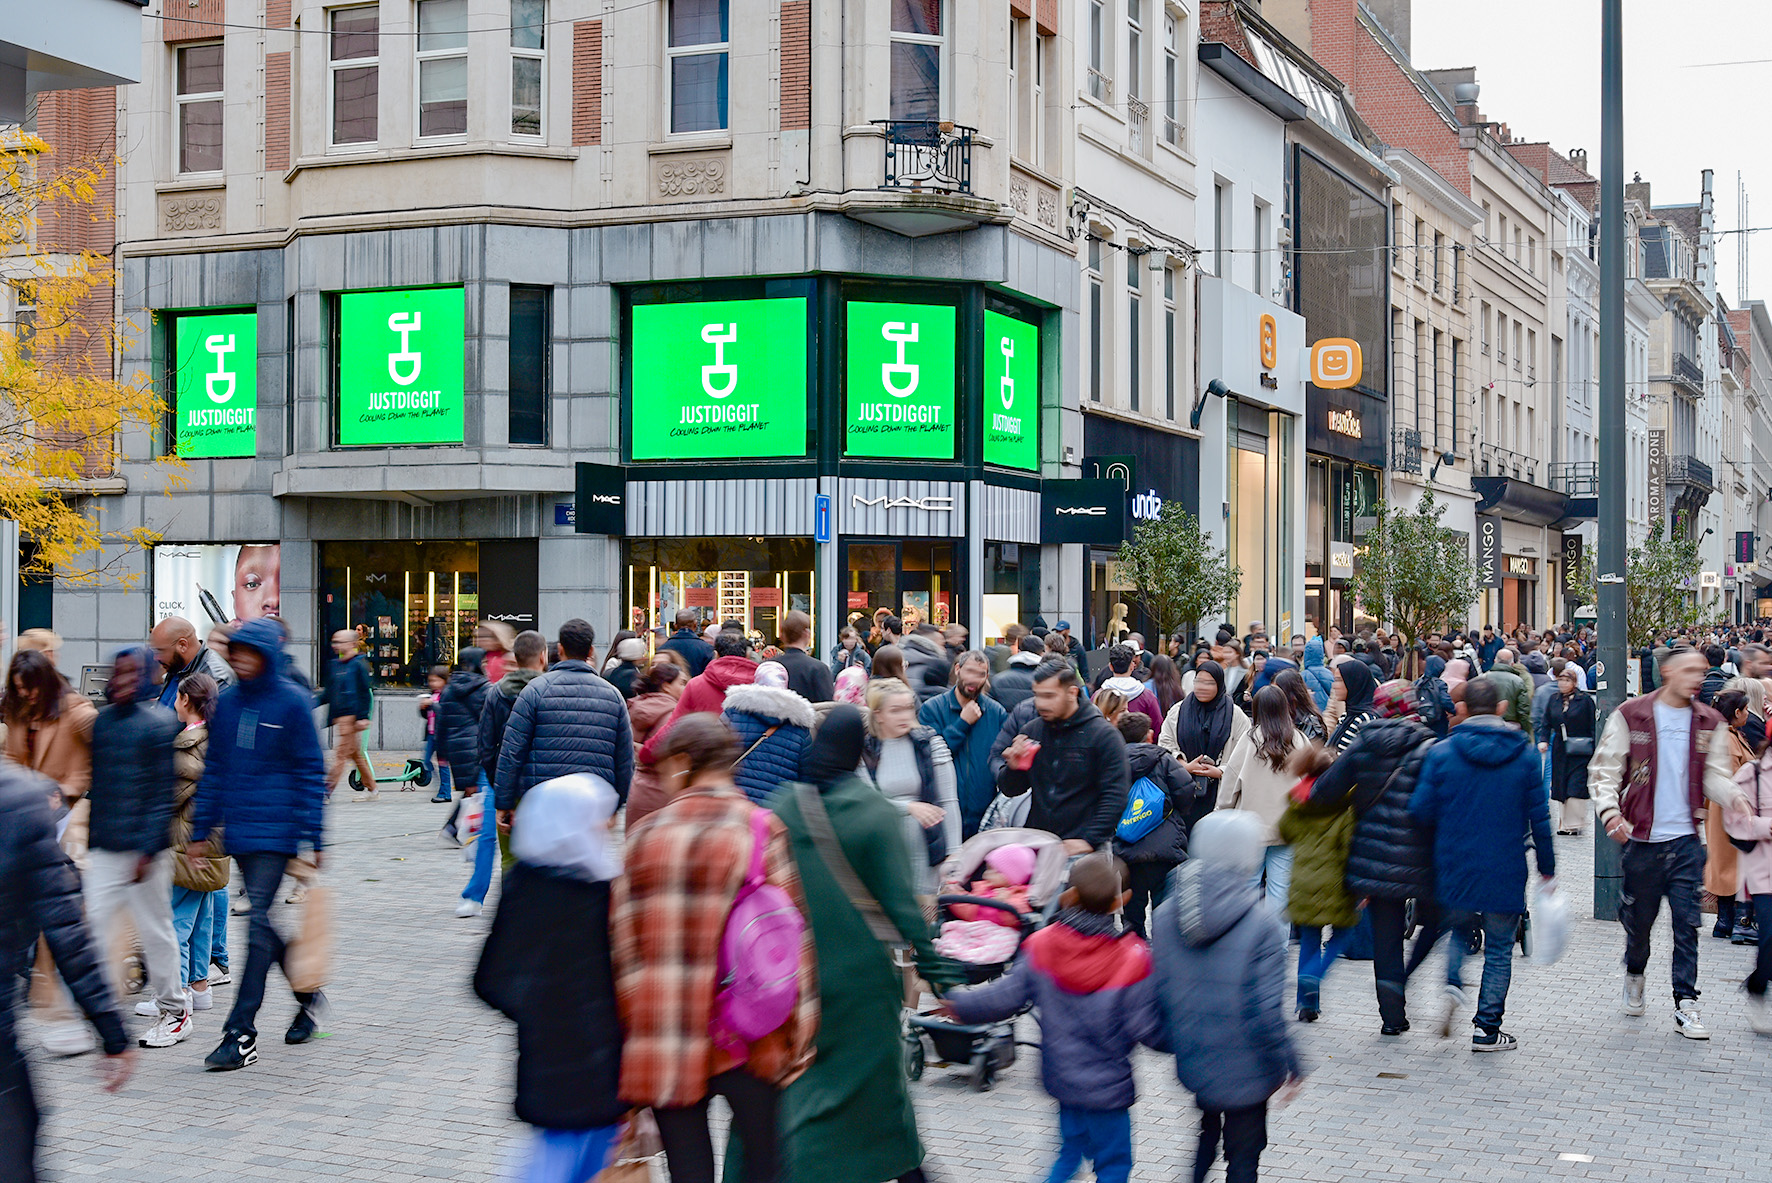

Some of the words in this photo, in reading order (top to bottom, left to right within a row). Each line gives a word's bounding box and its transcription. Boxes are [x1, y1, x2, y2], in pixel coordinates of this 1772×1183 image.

[368, 390, 441, 410] JUSTDIGGIT
[188, 408, 254, 426] JUSTDIGGIT
[680, 404, 759, 424] JUSTDIGGIT
[858, 402, 941, 423] JUSTDIGGIT
[992, 413, 1021, 435] JUSTDIGGIT
[1650, 431, 1660, 464] ZONE
[593, 494, 620, 504] MAC
[853, 495, 954, 510] MAC
[1132, 489, 1161, 521] undiz
[1650, 477, 1660, 522] AROMA
[1056, 507, 1106, 515] MAC
[159, 551, 201, 559] MAC
[1483, 522, 1494, 583] MANGO
[1510, 557, 1528, 574] MANGO
[1567, 538, 1577, 590] MANGO
[159, 601, 185, 610] CLICK,
[488, 614, 533, 622] MAC
[1121, 810, 1152, 825] ARTENGO
